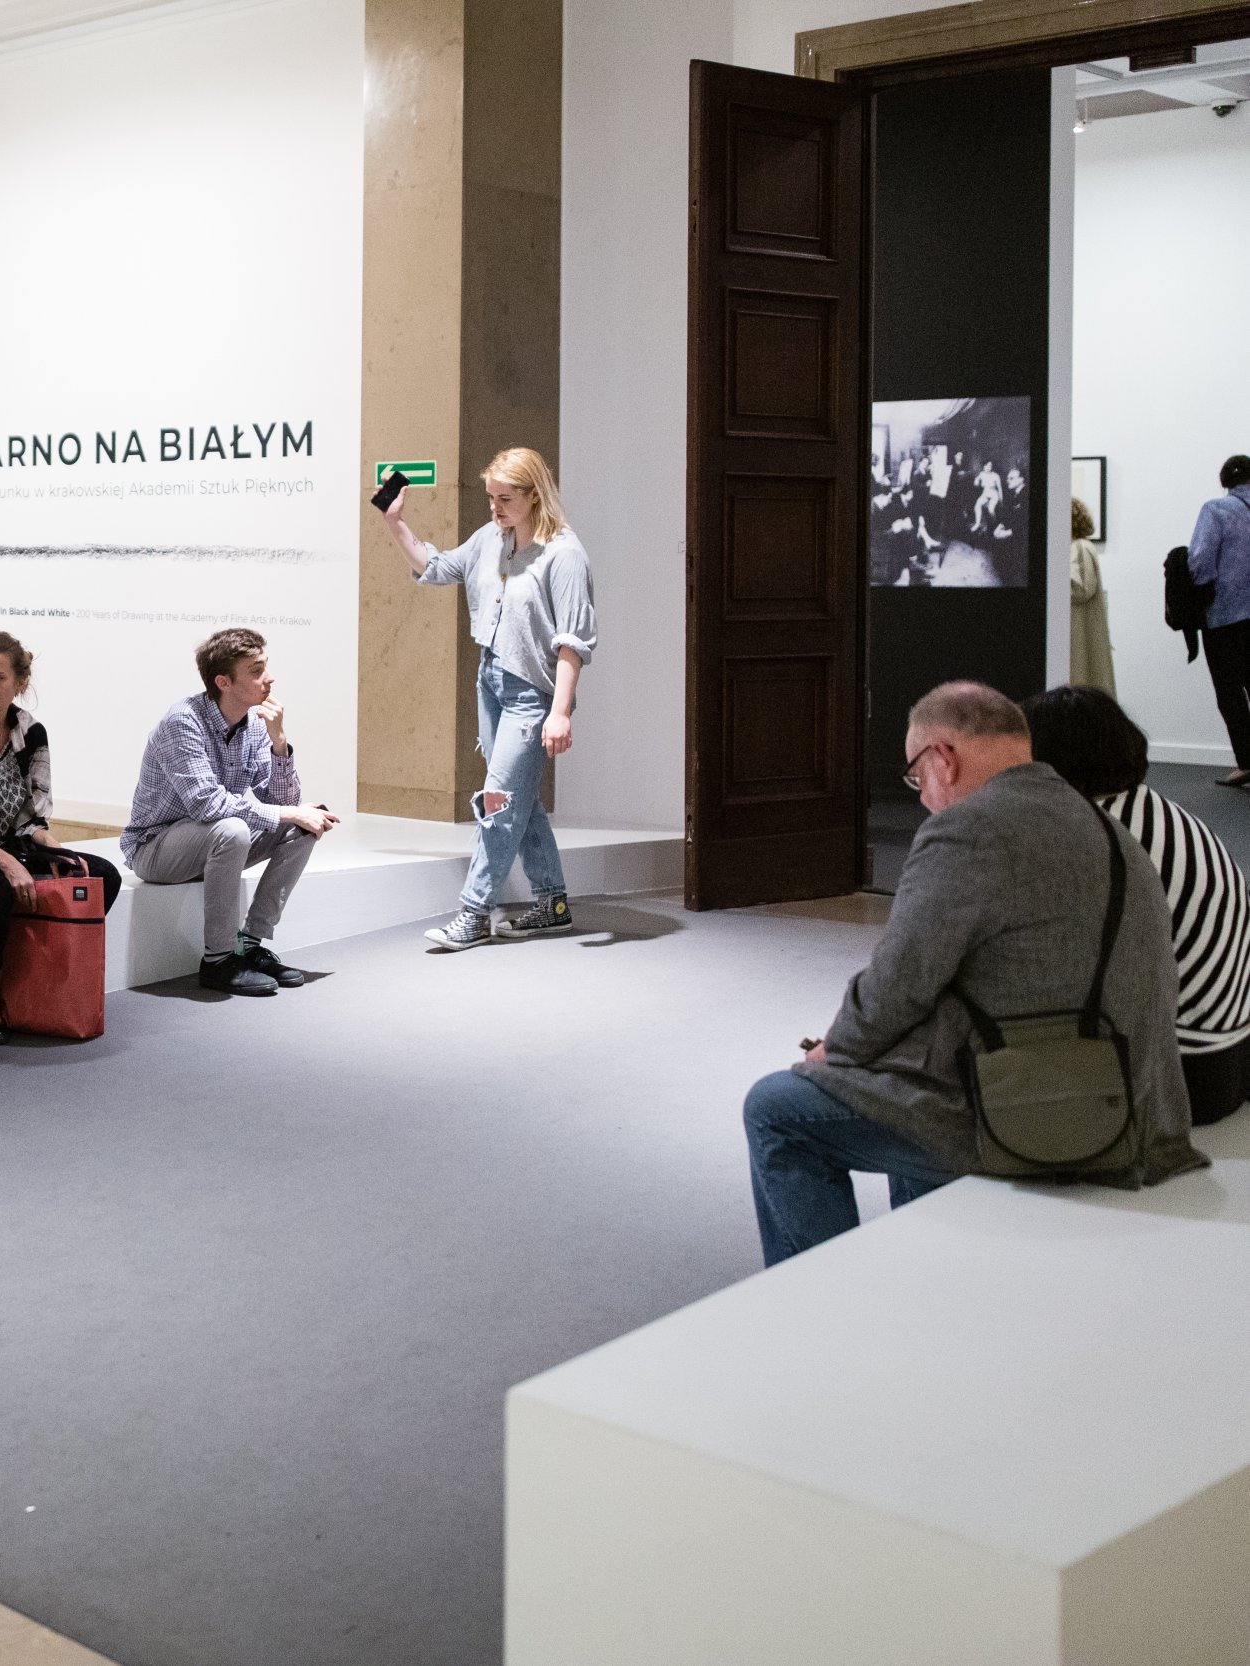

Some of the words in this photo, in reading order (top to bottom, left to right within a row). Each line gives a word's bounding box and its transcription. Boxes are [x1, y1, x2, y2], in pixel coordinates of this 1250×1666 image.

[95, 429, 147, 464] NA
[159, 420, 314, 462] BIAŁYM
[34, 487, 45, 498] w
[49, 483, 125, 501] krakowskiej
[129, 479, 195, 496] Akademii
[199, 479, 240, 495] Sztuk
[245, 477, 315, 497] Pięknych
[0, 607, 7, 616] In
[9, 607, 30, 617] Black
[31, 607, 46, 617] and
[47, 608, 71, 618] White
[76, 609, 90, 618] 200
[92, 609, 111, 620] Years
[112, 610, 120, 620] of
[122, 610, 155, 623] Drawing
[156, 613, 164, 622] at
[165, 612, 178, 622] the
[180, 612, 219, 625] Academy
[220, 612, 229, 623] of
[230, 613, 249, 624] Fine
[250, 614, 268, 625] Arts
[269, 614, 277, 624] in
[279, 615, 312, 626] Krakow
